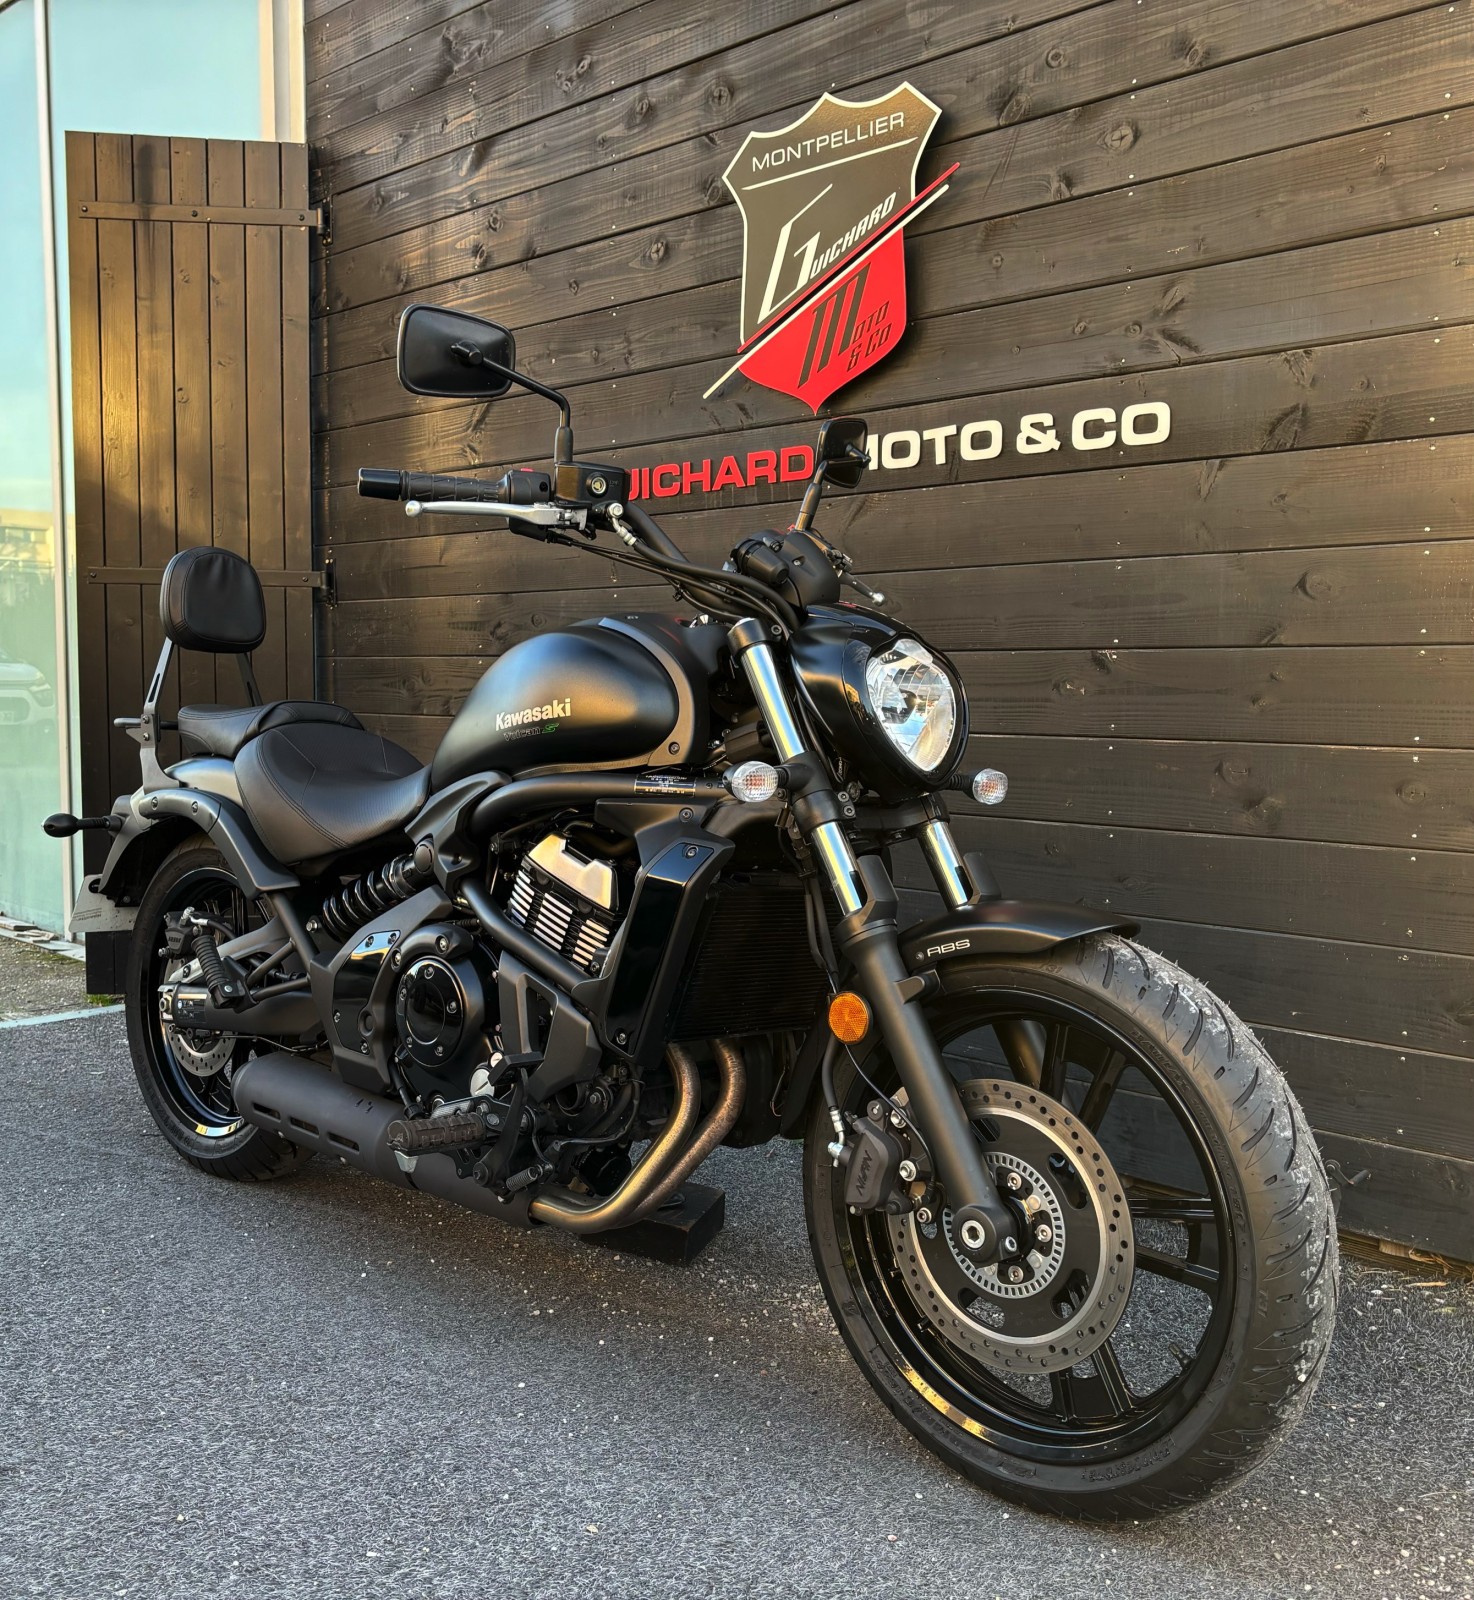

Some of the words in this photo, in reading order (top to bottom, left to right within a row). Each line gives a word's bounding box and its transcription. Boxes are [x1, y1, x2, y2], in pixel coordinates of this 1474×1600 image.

[752, 111, 905, 172] MONTPELLIER
[757, 183, 897, 325] GUICHARD
[797, 261, 890, 389] MOTO
[865, 322, 892, 358] CO
[628, 444, 814, 501] ICHARD
[1016, 412, 1061, 455] &
[1072, 401, 1171, 450] CO
[495, 697, 571, 731] Kawasaki
[926, 938, 971, 957] ABS
